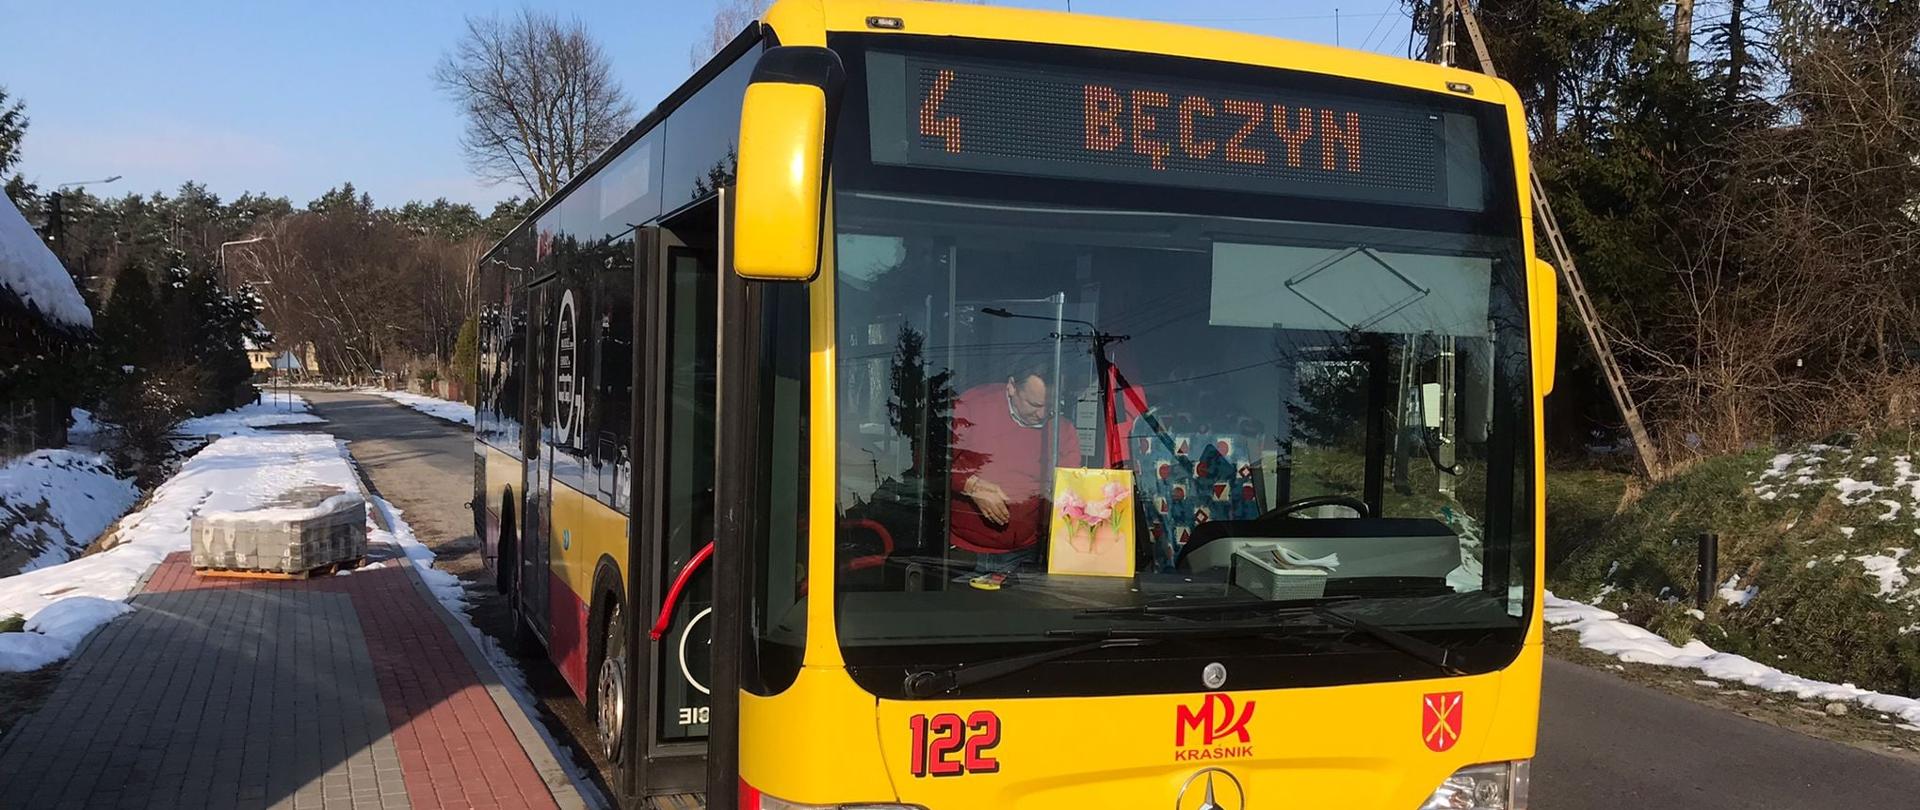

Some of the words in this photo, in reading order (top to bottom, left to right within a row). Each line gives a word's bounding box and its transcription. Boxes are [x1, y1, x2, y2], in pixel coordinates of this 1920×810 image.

[919, 69, 961, 154] 4
[1083, 84, 1361, 171] BĘCZYN
[910, 710, 1002, 778] 122
[1176, 692, 1256, 747] MPK
[1175, 744, 1253, 761] KRAŚNIK
